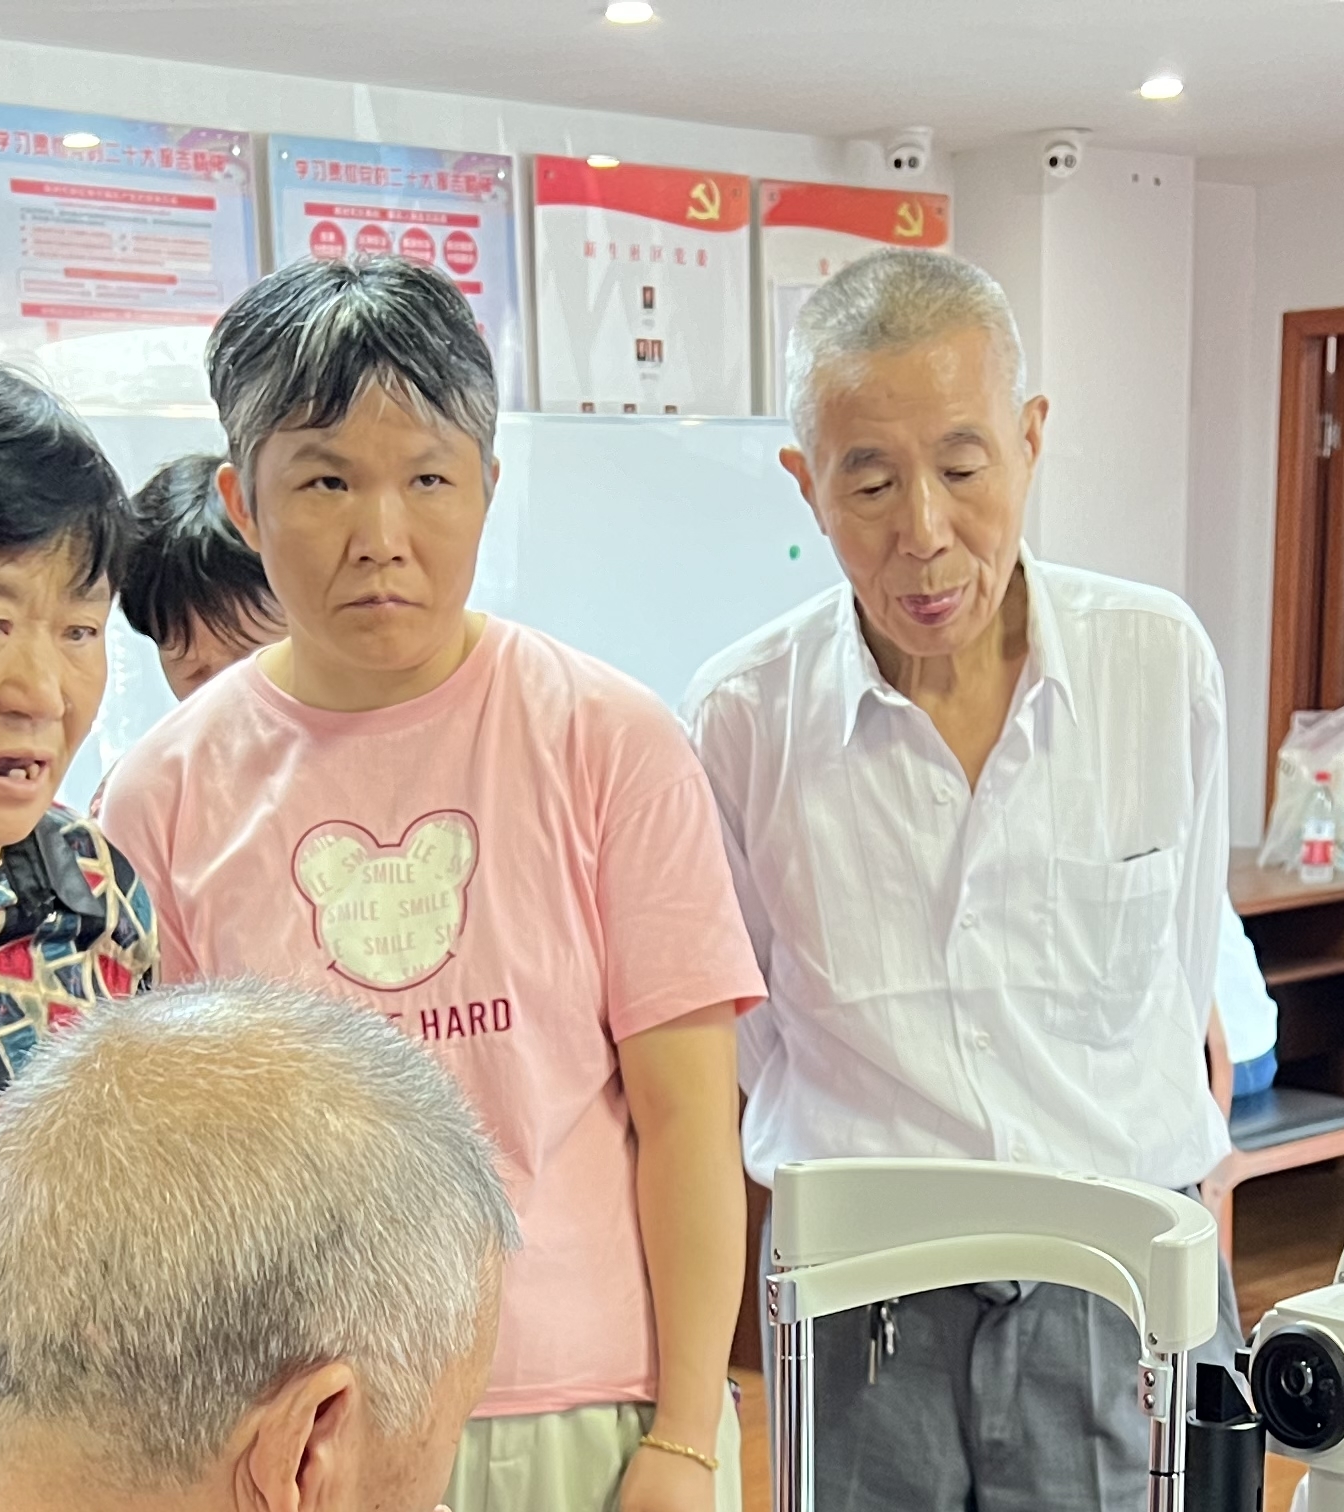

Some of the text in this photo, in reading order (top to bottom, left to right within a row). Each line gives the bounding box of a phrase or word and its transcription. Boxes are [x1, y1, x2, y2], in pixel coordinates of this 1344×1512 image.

[362, 863, 416, 884] SMILE
[327, 901, 380, 924] SMILE
[399, 890, 449, 919] SMILE
[363, 931, 416, 956] SMILE
[420, 998, 512, 1041] HARD
